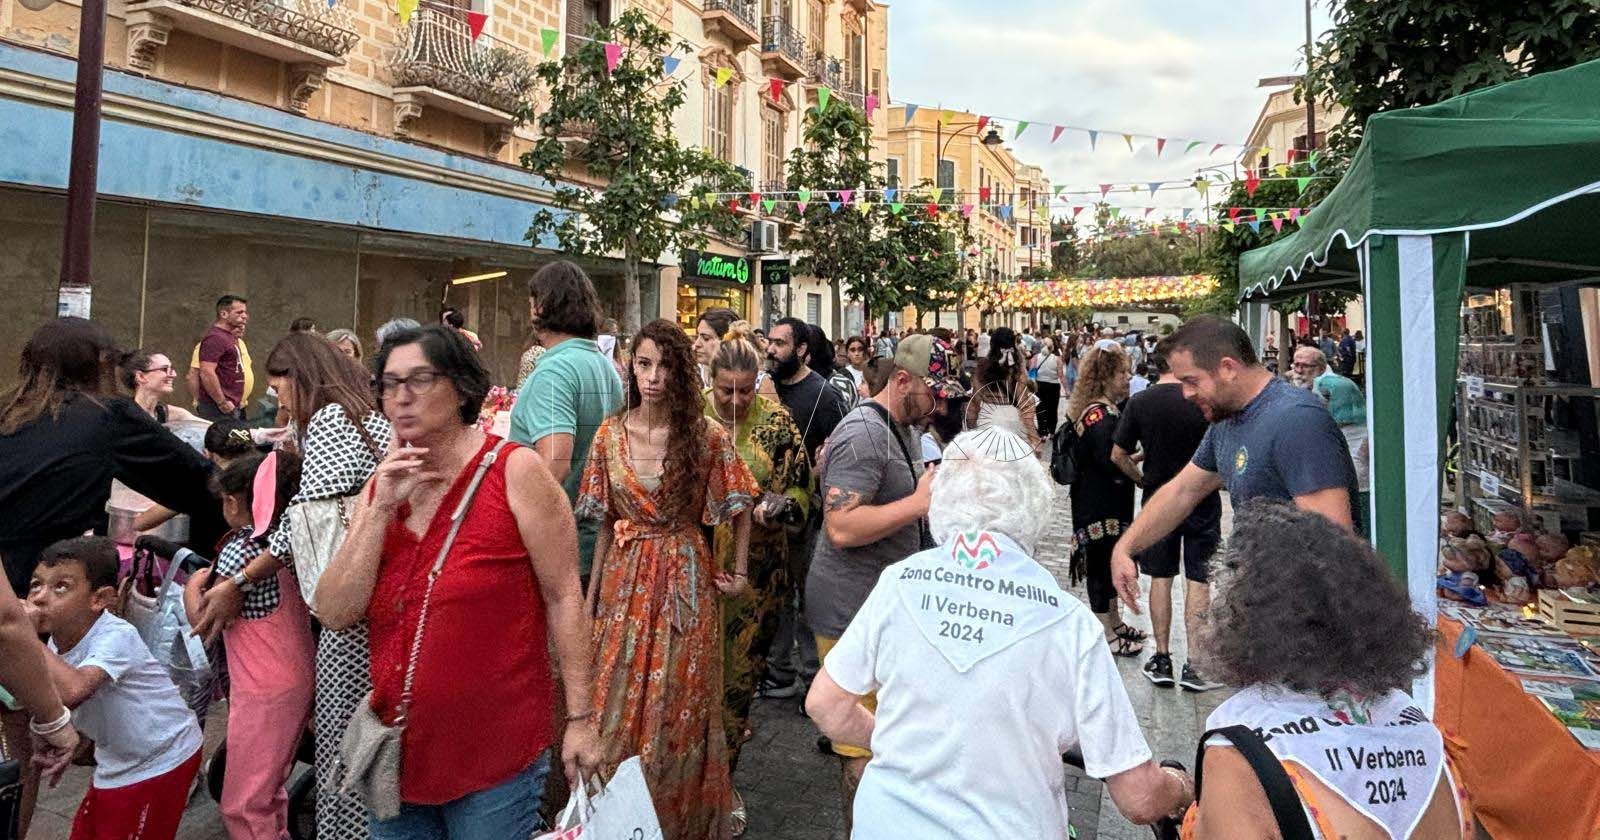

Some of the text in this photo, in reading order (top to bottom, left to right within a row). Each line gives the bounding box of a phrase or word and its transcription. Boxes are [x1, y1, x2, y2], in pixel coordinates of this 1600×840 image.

[899, 567, 1059, 608] Zona Centro Melilla
[936, 596, 1015, 627] Verbena
[939, 621, 984, 644] 2024
[1347, 746, 1427, 770] Verbena
[1365, 777, 1408, 805] 2024
